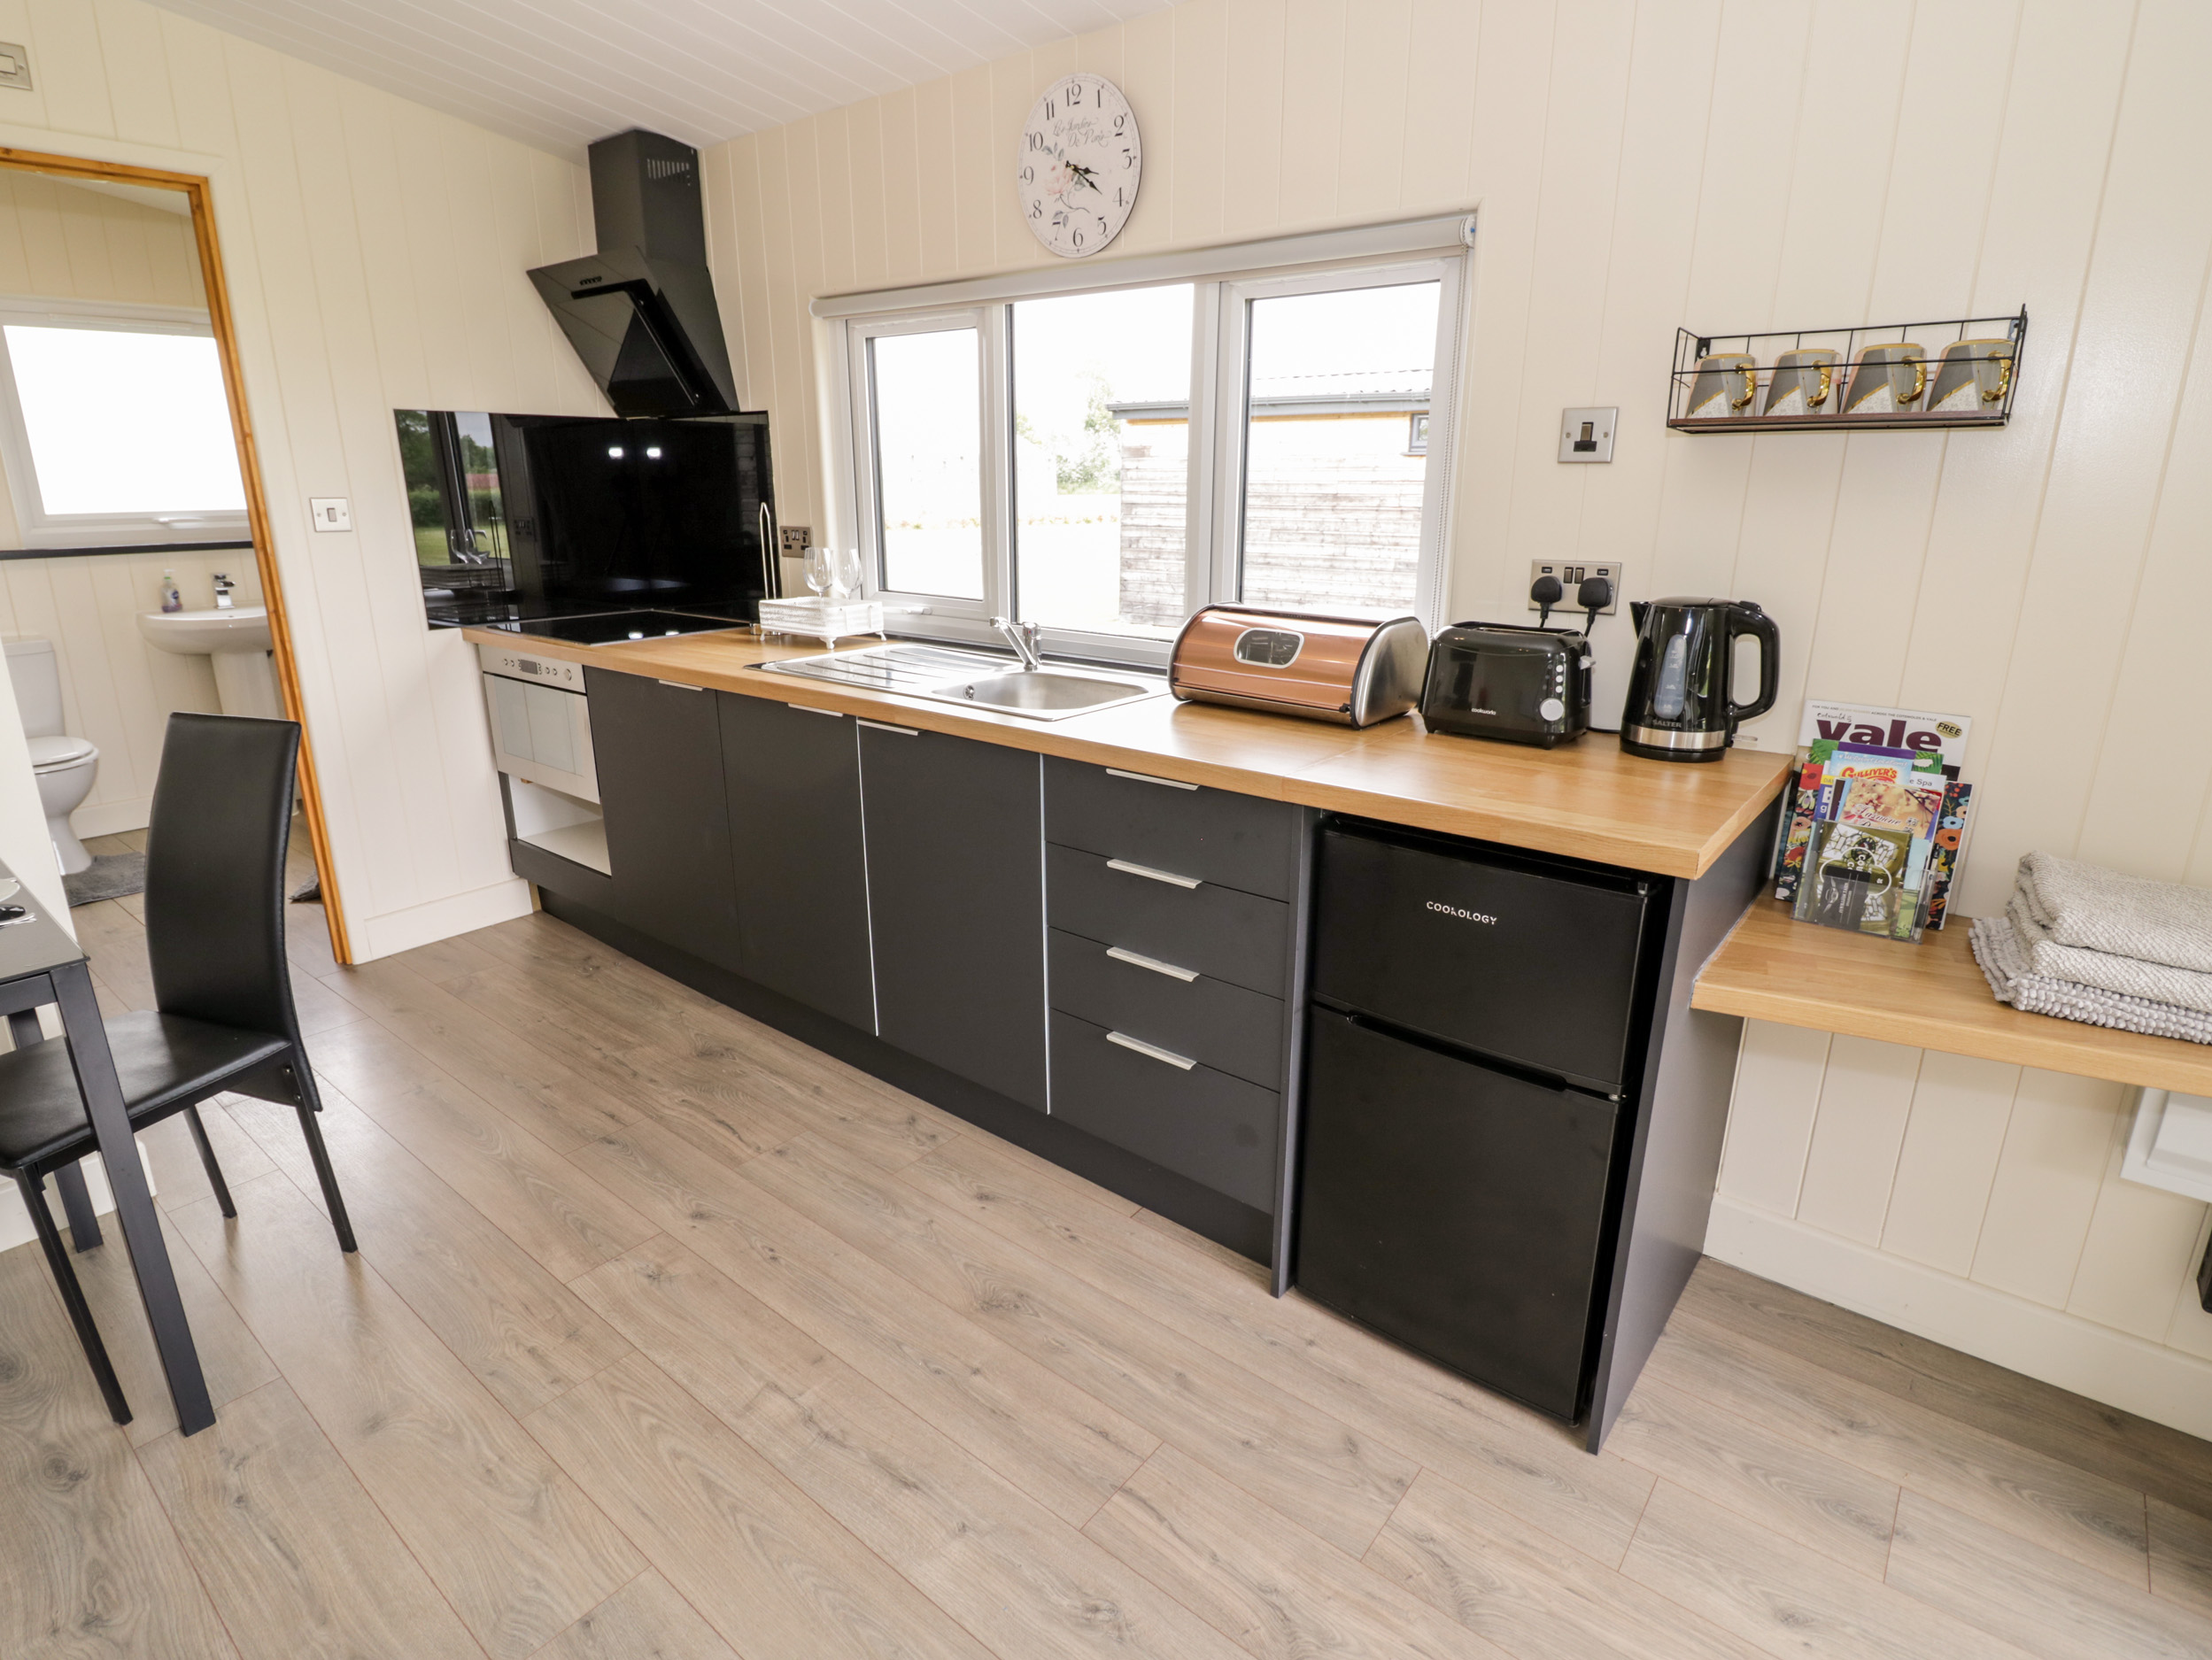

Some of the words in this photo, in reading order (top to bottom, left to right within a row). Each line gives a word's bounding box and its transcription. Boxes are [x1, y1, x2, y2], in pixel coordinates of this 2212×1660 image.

[1065, 83, 1082, 107] 12
[1096, 89, 1102, 108] 1
[1046, 100, 1055, 120] 11
[1113, 114, 1125, 137] 2
[1028, 130, 1044, 152] 10
[1121, 148, 1133, 170] 3
[1023, 165, 1034, 186] 9
[1112, 187, 1123, 207] 4
[1033, 199, 1043, 220] 8
[1052, 220, 1062, 241] 7
[1096, 216, 1107, 235] 5
[1072, 227, 1084, 248] 6
[1652, 719, 1682, 729] SALTER
[1937, 722, 1962, 737] FREE
[1816, 719, 1942, 753] vale
[1426, 900, 1498, 925] COOKOLOGY
